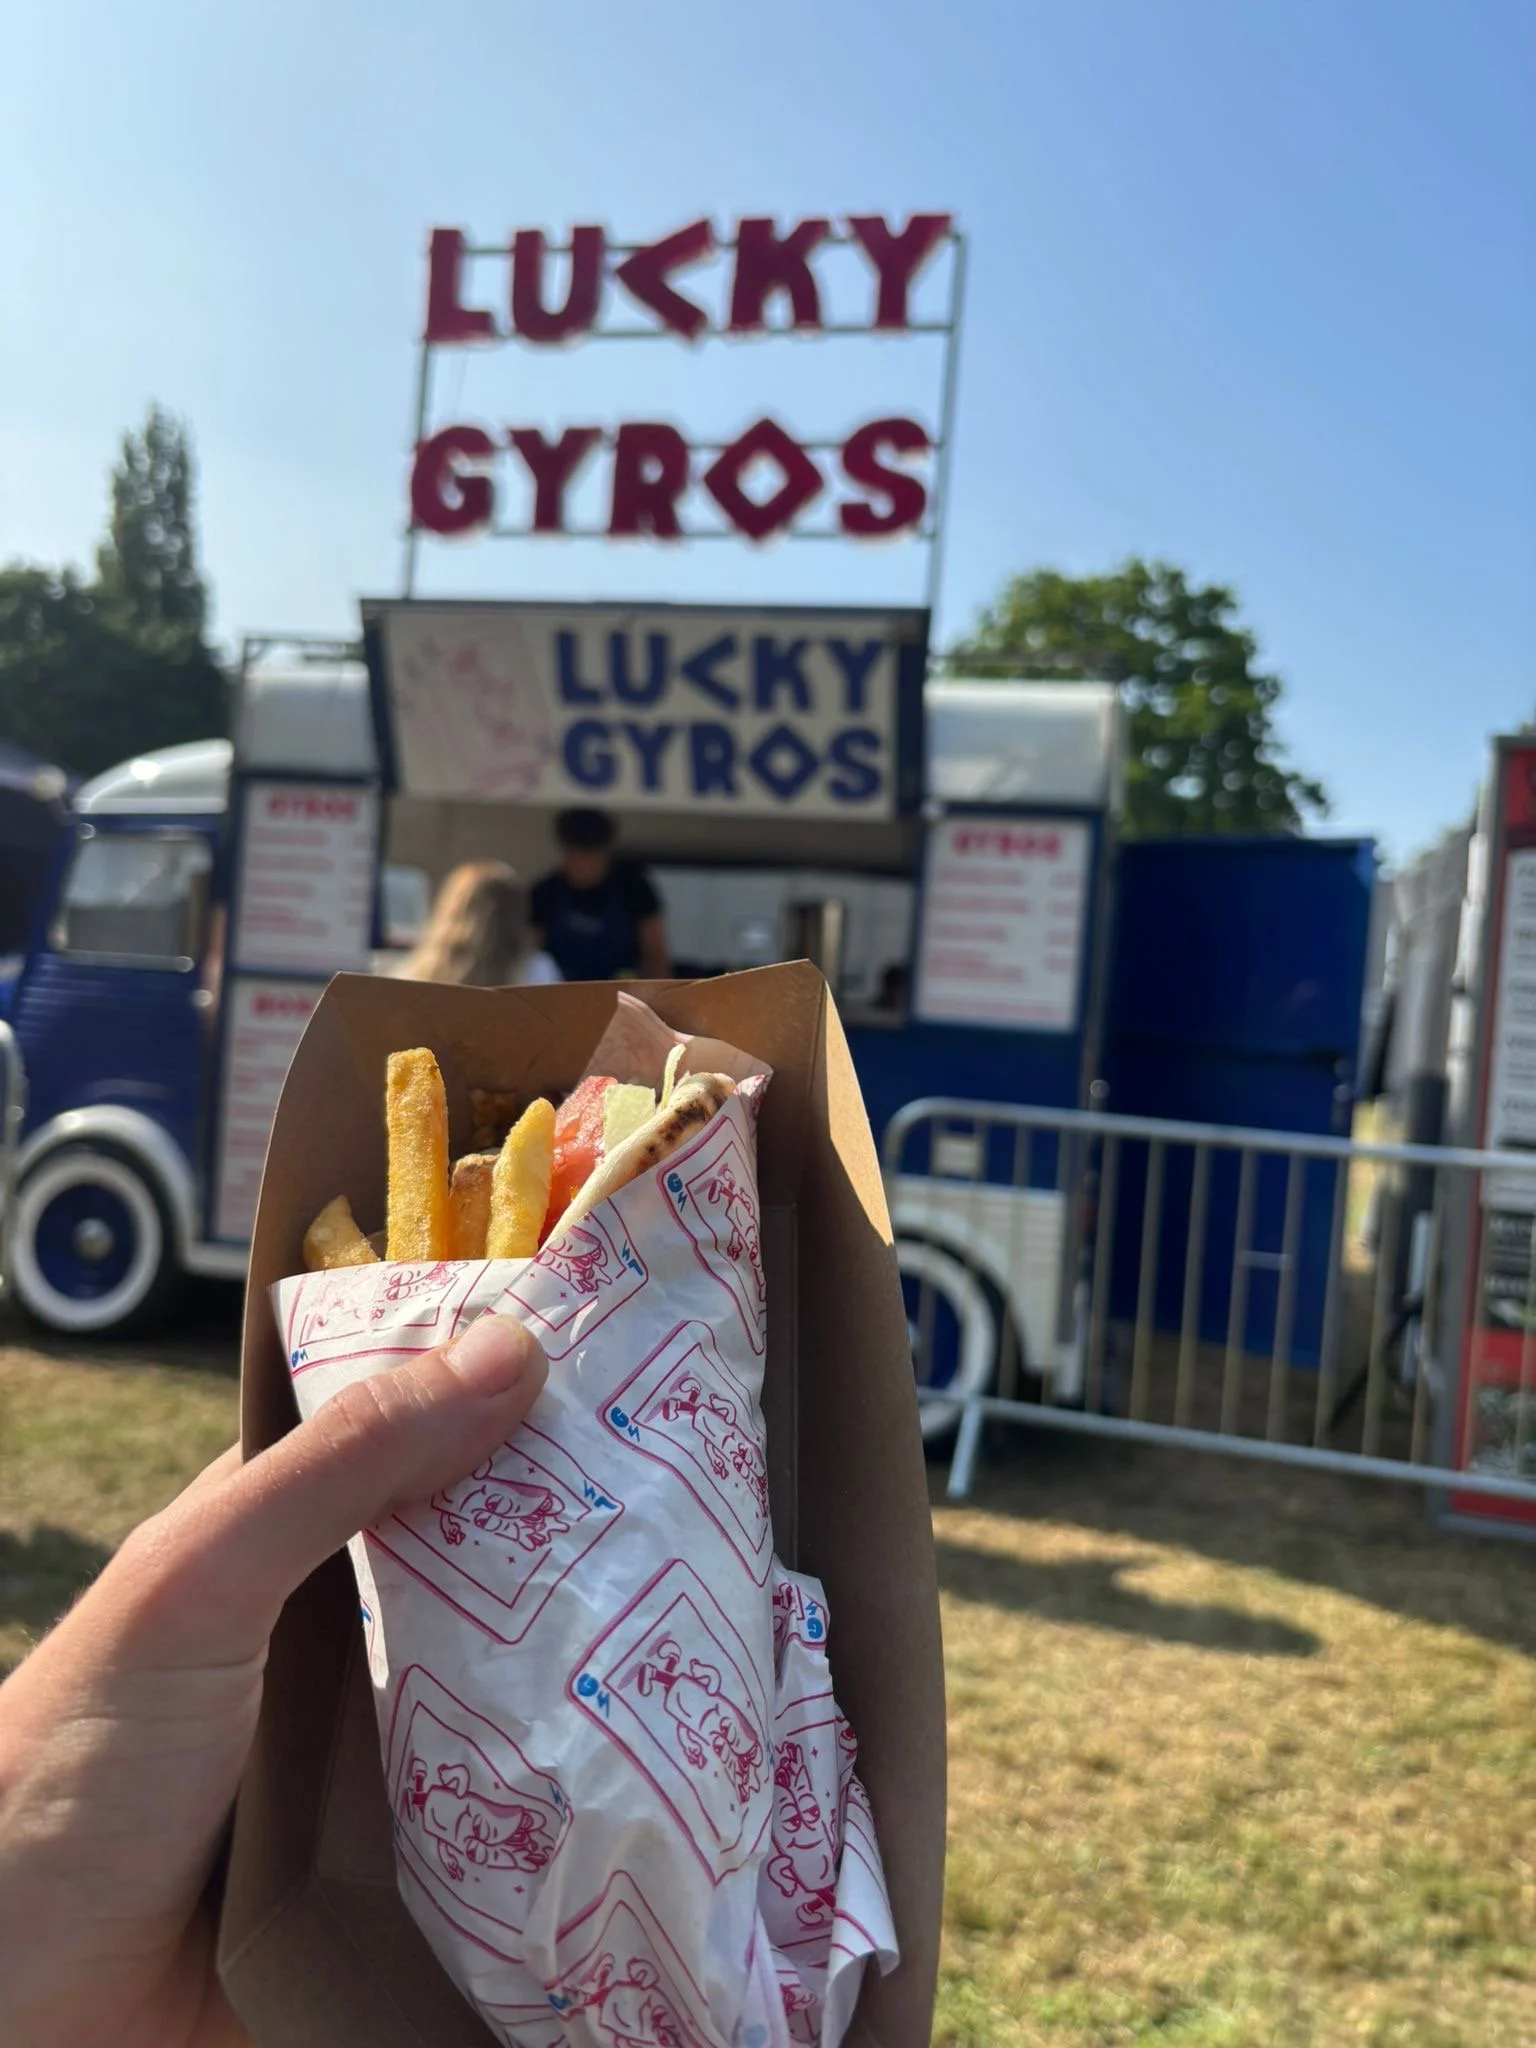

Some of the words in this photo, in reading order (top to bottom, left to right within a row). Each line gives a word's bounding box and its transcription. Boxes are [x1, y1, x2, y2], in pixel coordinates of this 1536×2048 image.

[426, 213, 951, 343] LUCKY
[409, 416, 933, 543] GYROS
[553, 629, 888, 717] LUCKY
[560, 716, 886, 806] GYROS
